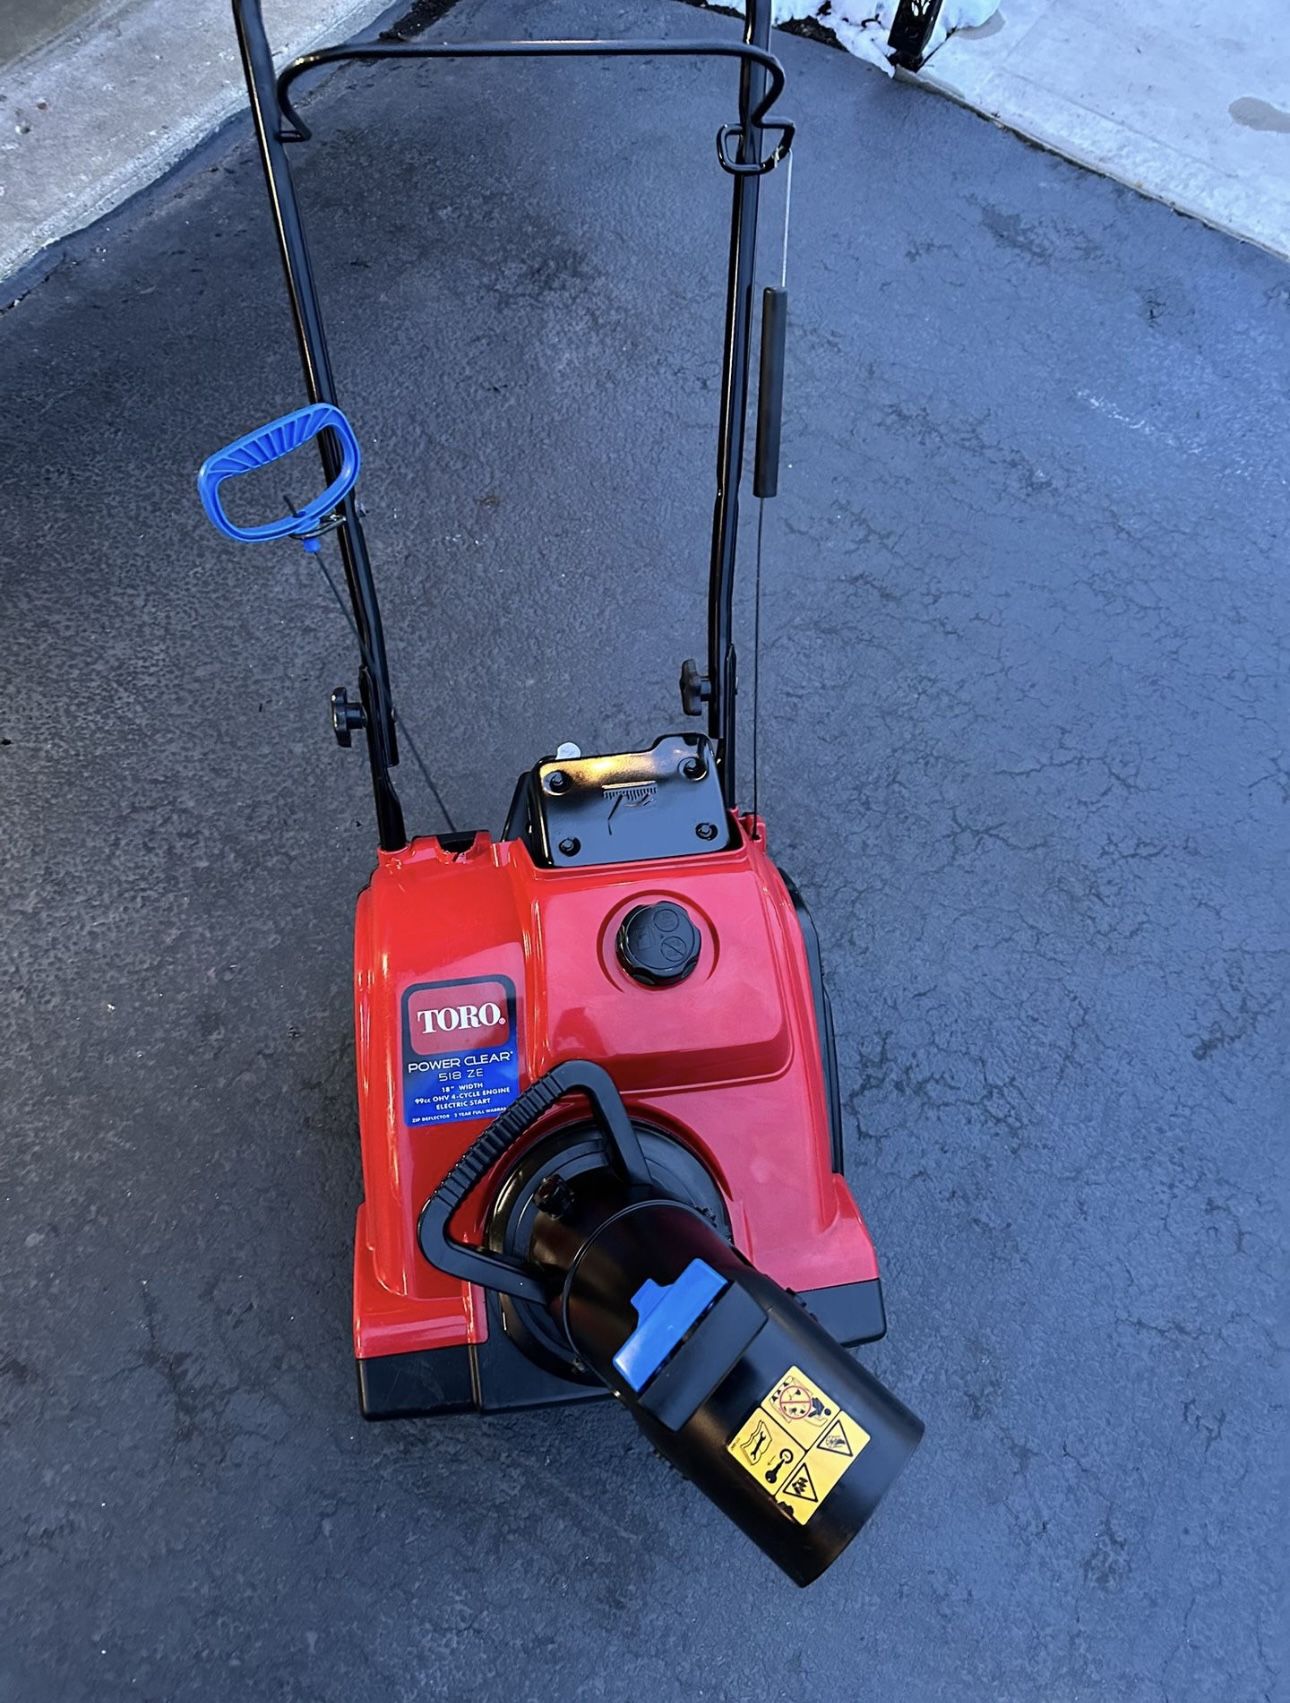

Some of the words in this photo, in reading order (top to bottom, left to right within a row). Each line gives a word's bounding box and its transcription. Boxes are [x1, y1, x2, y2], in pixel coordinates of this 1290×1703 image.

[408, 1058, 460, 1073] POWER
[439, 1071, 461, 1082] 518
[467, 1068, 484, 1078] ZE
[458, 1082, 483, 1090] WIDTH
[451, 1091, 480, 1099] 4-CYCLE
[482, 1087, 510, 1095] ENGINE
[436, 1101, 468, 1110] ELECTRIC
[469, 1098, 491, 1106] START
